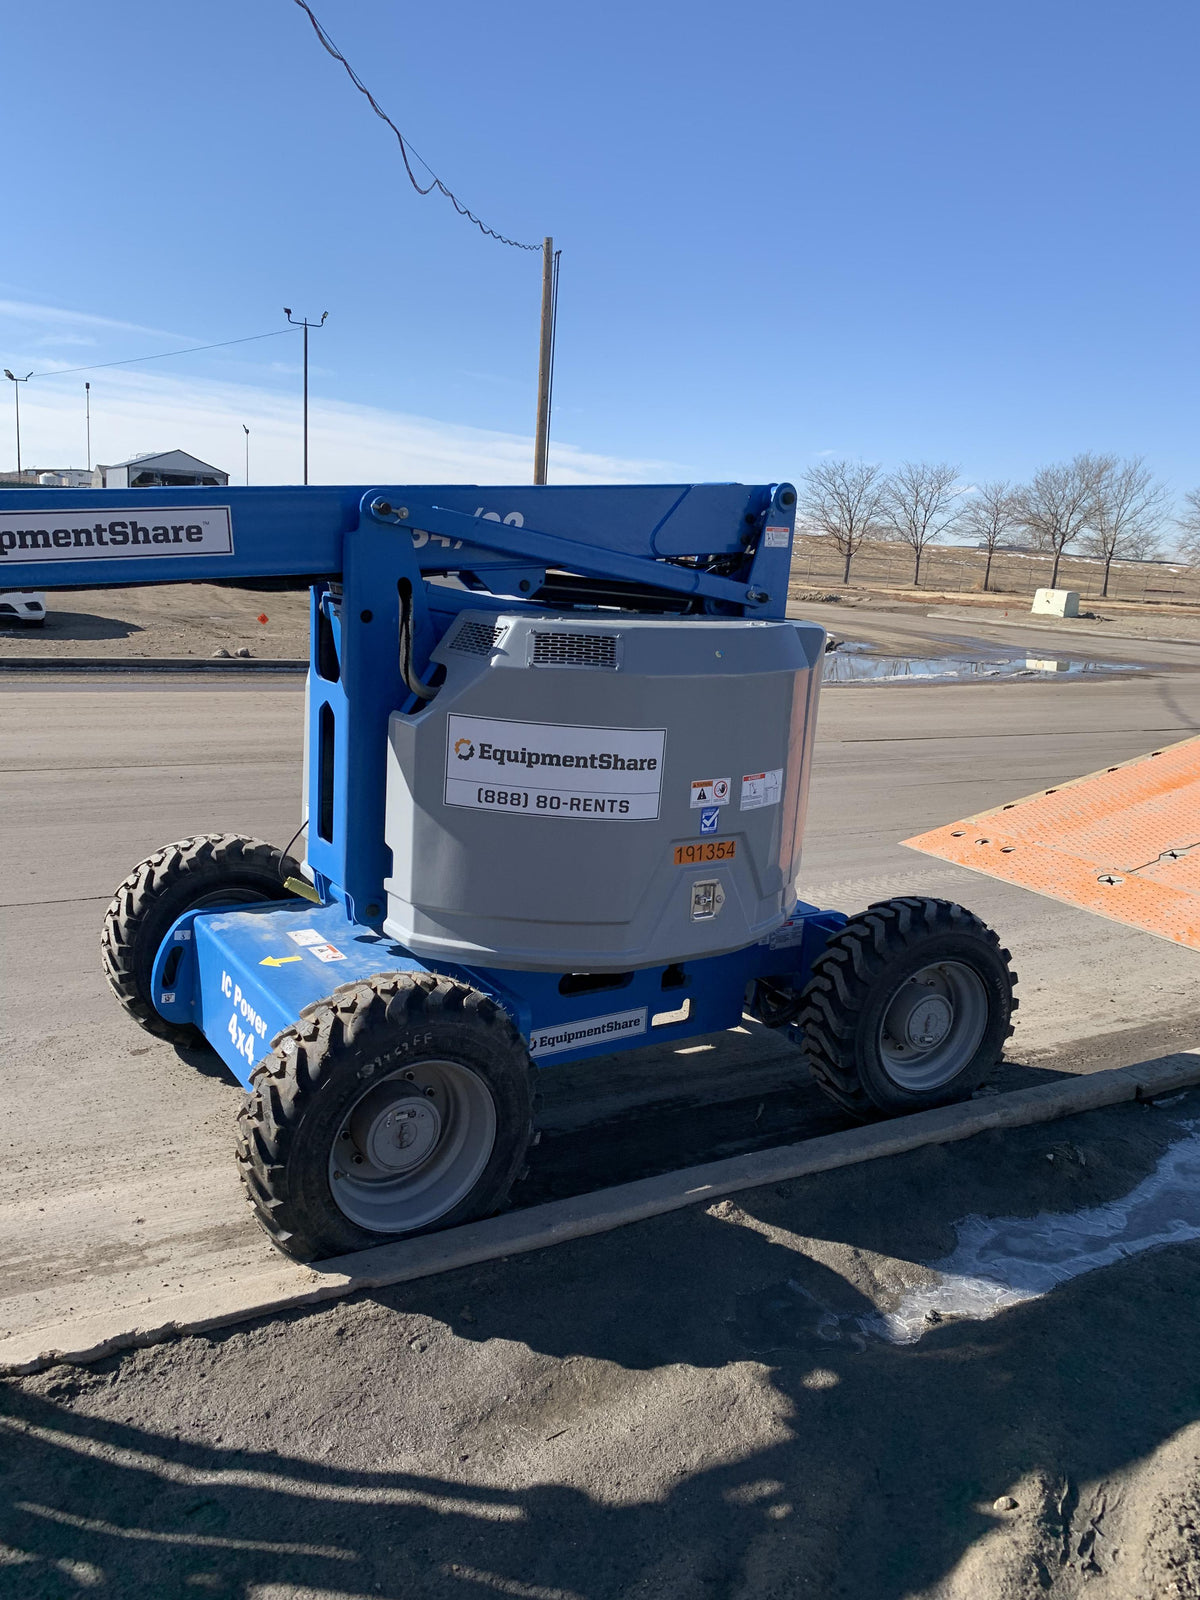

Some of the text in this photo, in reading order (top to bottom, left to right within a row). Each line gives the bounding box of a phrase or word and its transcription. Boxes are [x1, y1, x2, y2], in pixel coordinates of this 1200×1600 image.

[478, 742, 657, 771] EquipmentShare
[477, 787, 630, 814] (888) 80-RENTS
[676, 840, 736, 864] 191354
[221, 969, 268, 1040] IC Power
[228, 1012, 255, 1066] 4x4
[539, 1017, 641, 1048] EquipmentShare
